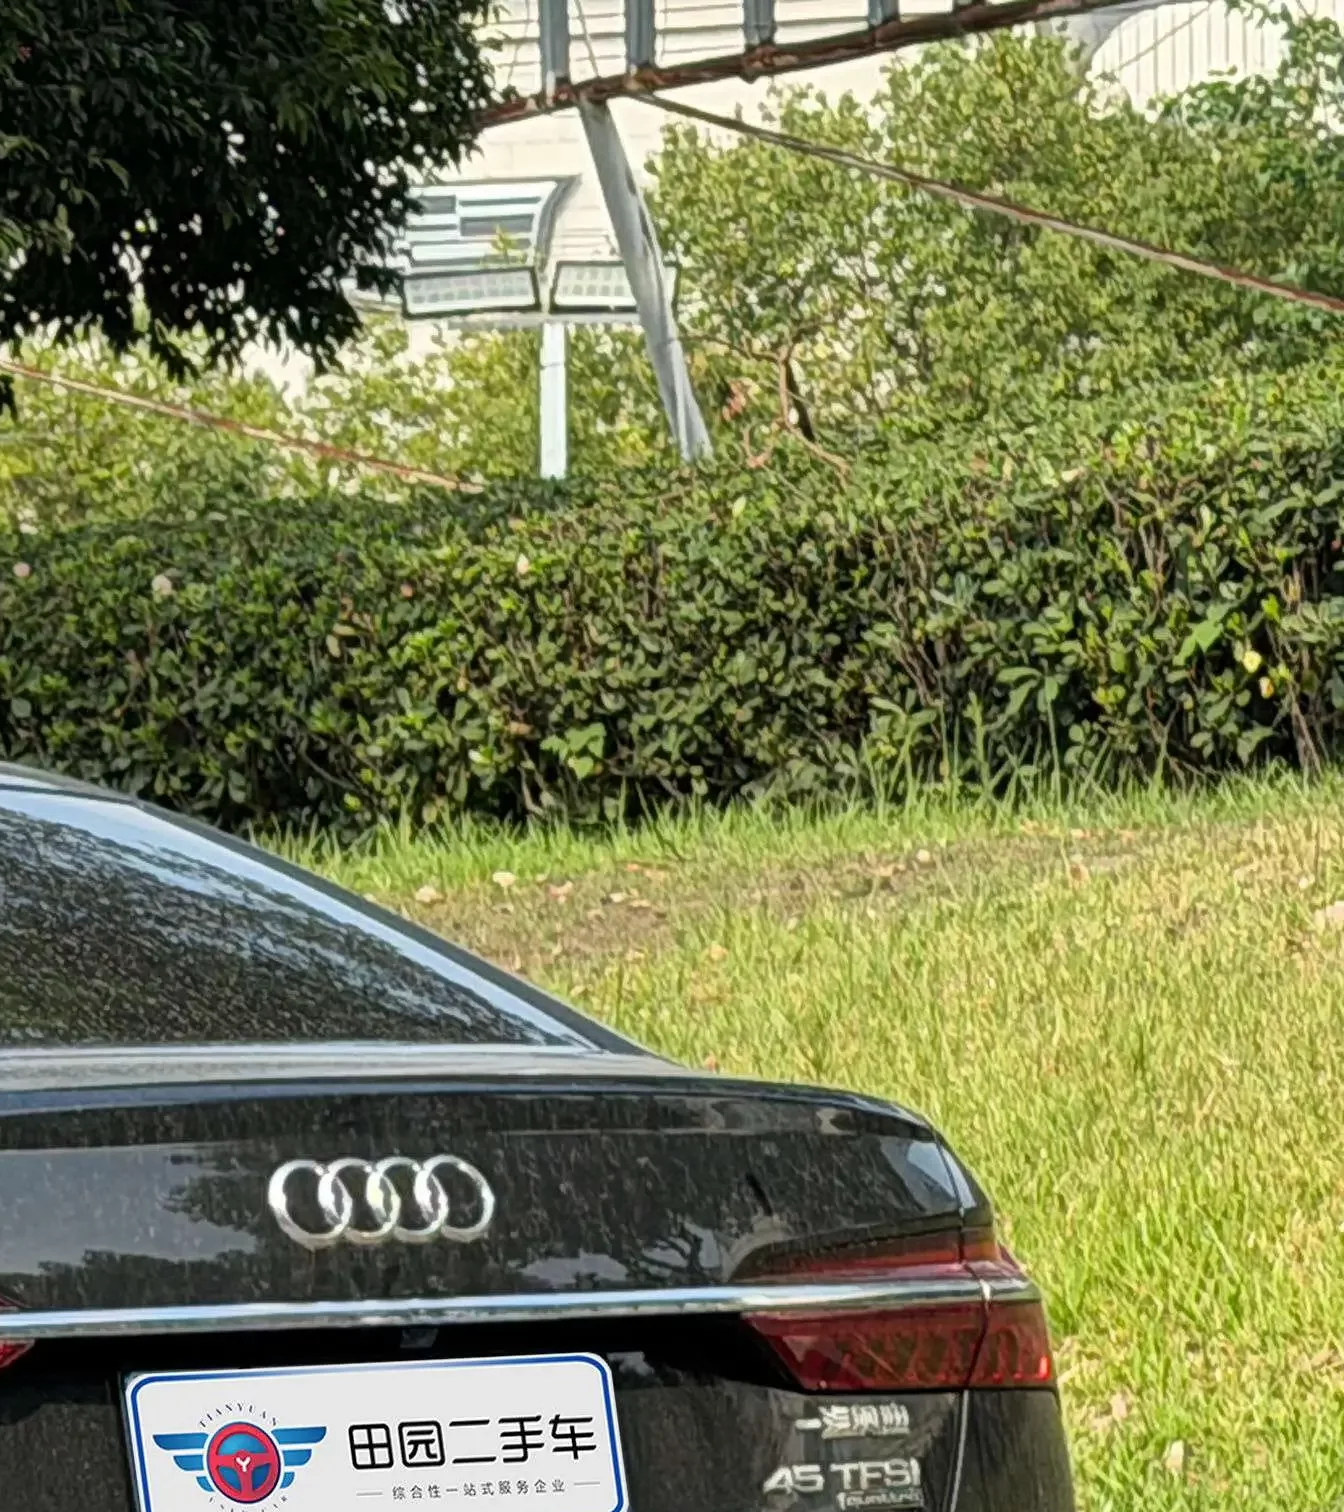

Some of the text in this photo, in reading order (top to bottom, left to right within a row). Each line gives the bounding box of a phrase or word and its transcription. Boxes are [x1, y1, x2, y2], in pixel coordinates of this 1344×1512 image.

[348, 1414, 598, 1470] 田园二手车
[392, 1479, 566, 1500] 综合性一站式服务企业
[830, 1458, 921, 1490] TFSI
